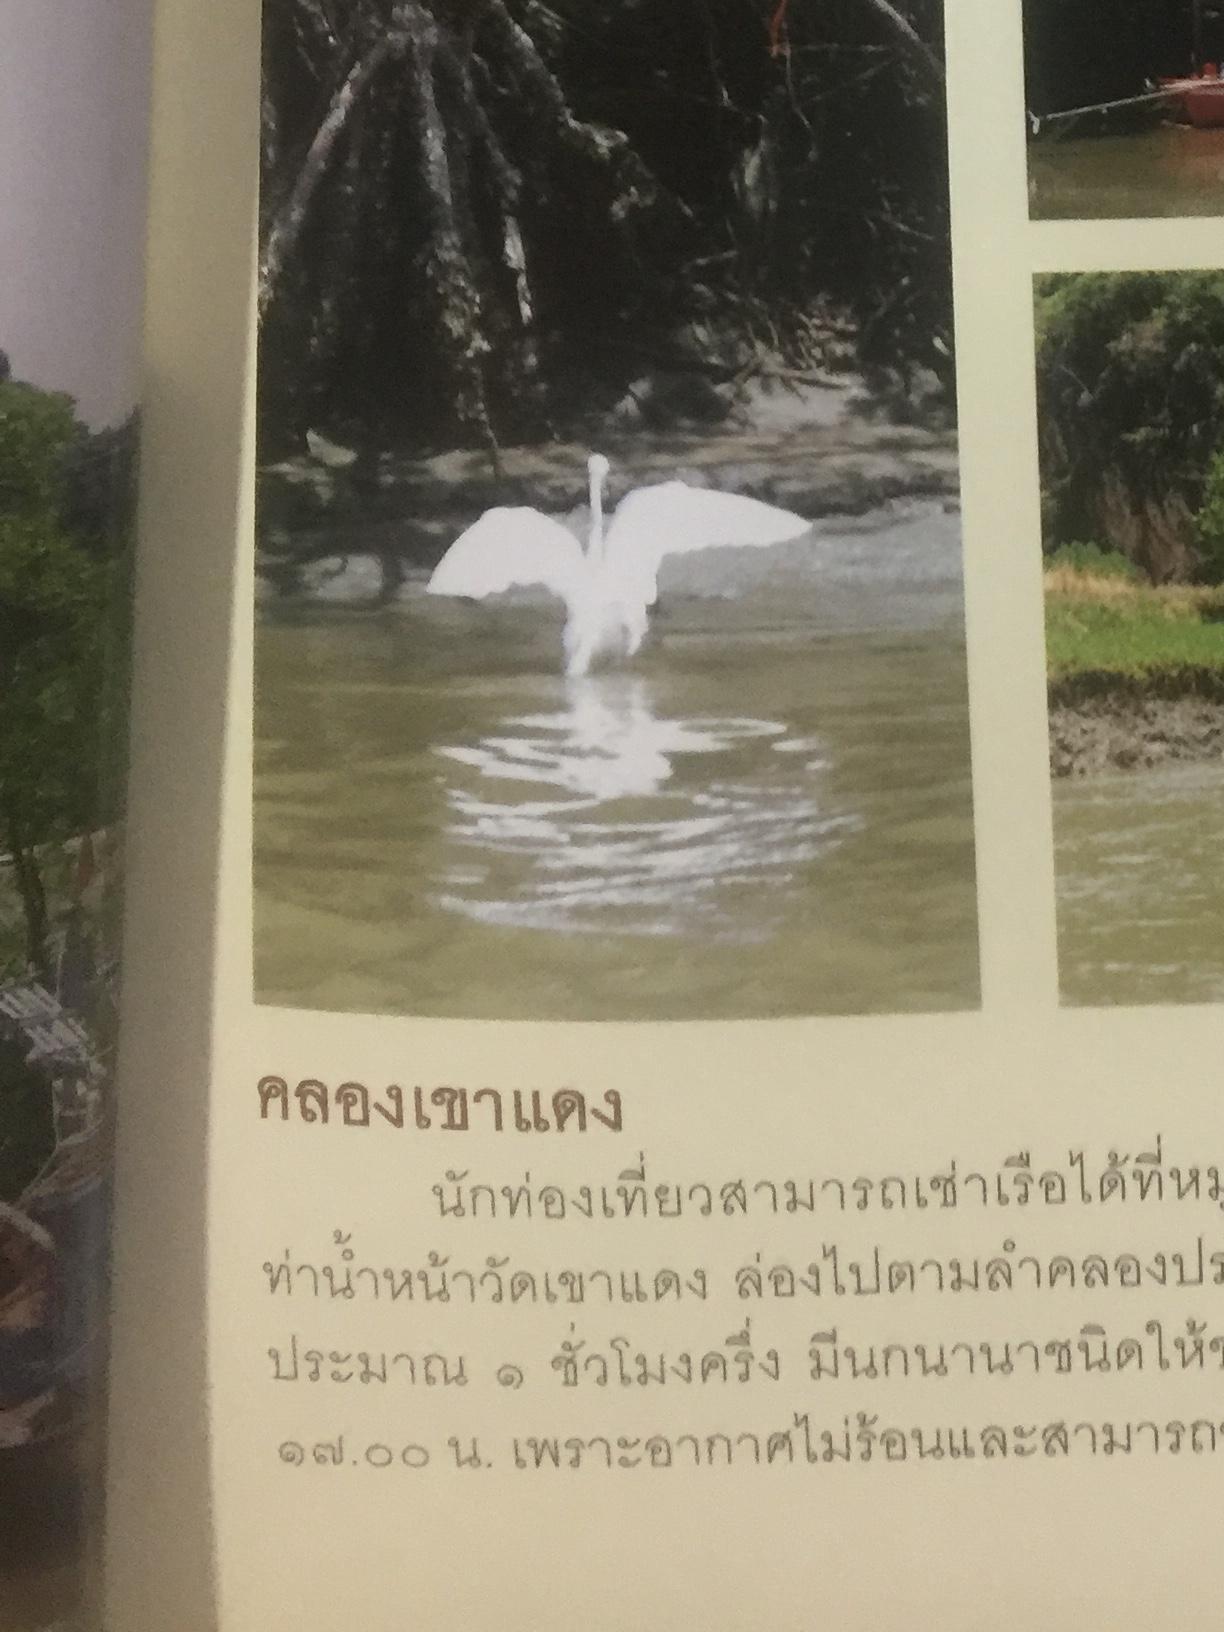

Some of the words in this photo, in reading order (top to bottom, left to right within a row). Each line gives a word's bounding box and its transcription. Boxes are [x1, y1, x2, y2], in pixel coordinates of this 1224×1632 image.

[256, 1074, 623, 1134] คลองเขาแดง
[262, 1228, 708, 1305] ท่าน้ำหน้าวัดเขาแดง
[267, 1334, 469, 1387] ประมาณ
[495, 1363, 524, 1390] ๑
[550, 1316, 780, 1388] ชั่วโมงครึ่ง
[277, 1434, 430, 1469] ๑๗.๐๐
[447, 1436, 493, 1469] น.
